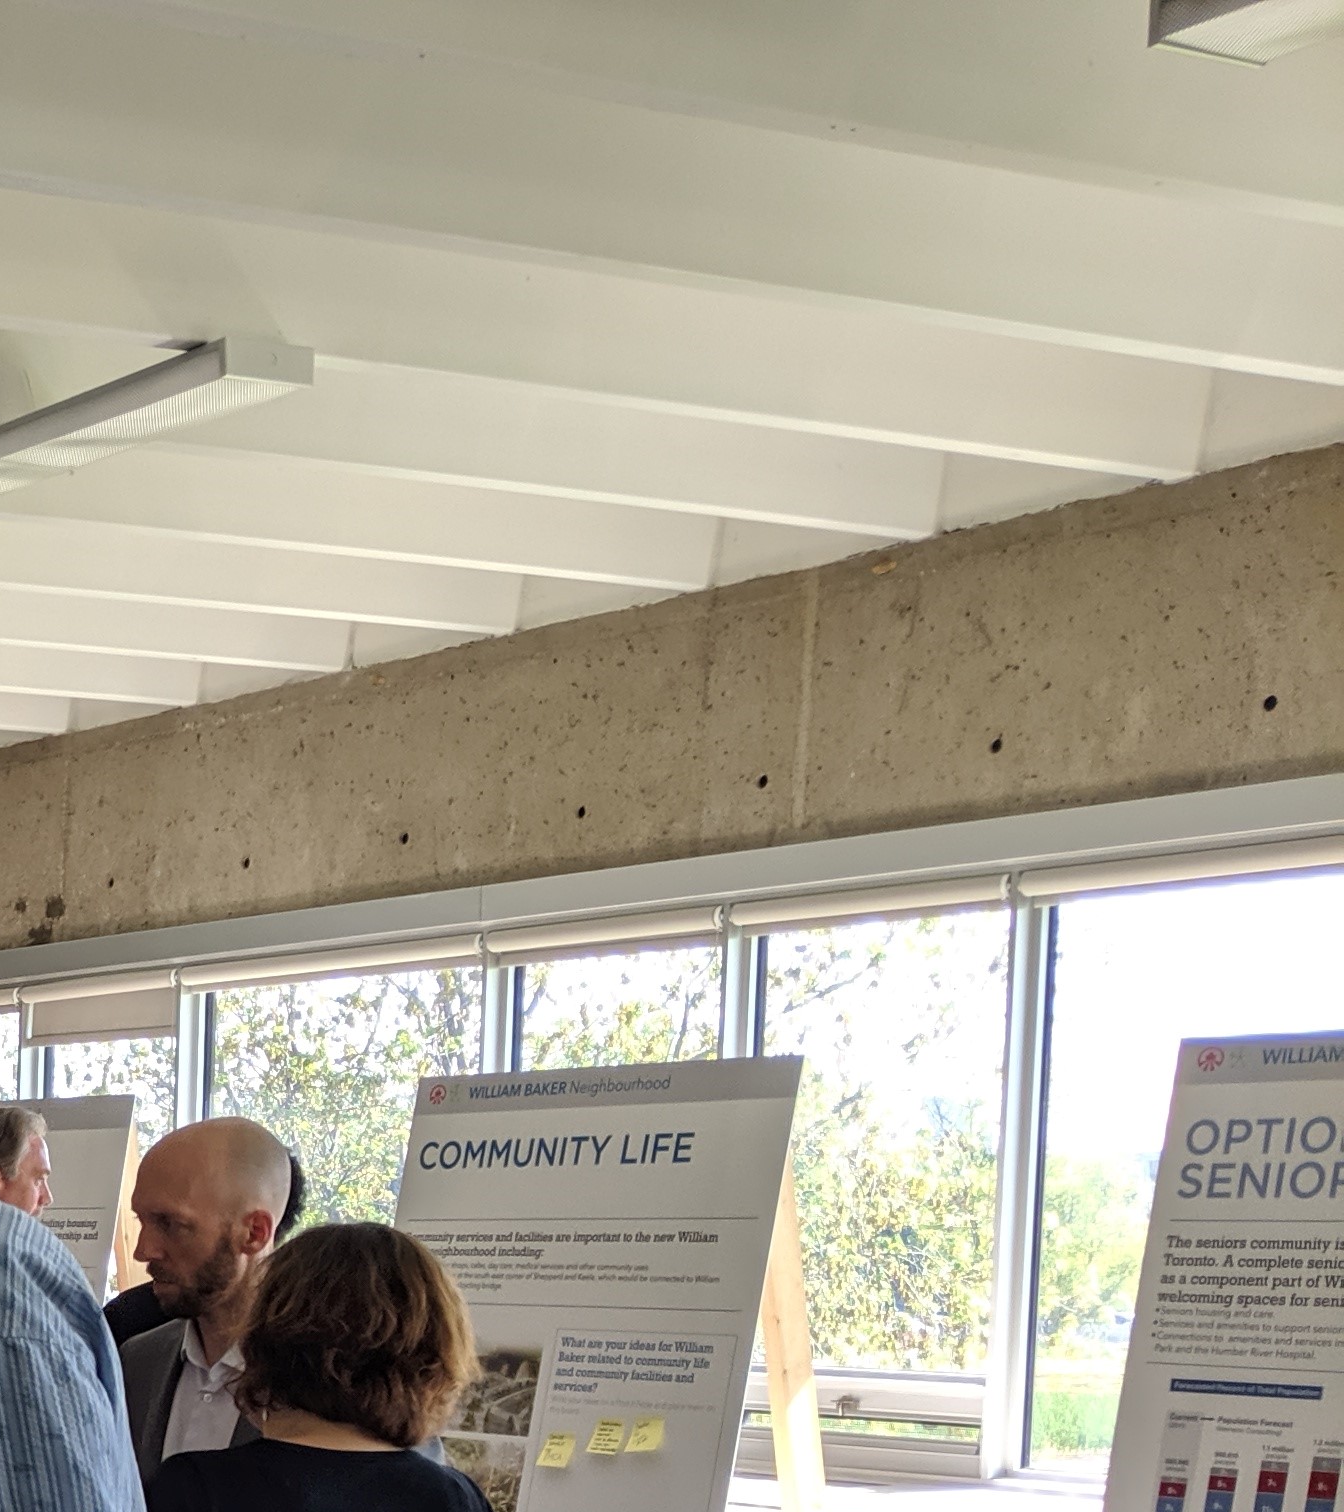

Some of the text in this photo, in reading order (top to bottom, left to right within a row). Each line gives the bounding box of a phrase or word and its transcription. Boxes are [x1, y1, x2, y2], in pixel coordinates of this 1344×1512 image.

[1263, 1045, 1344, 1064] WILLIAM
[469, 1076, 671, 1099] WILLIAM BAKER Neighbourhood
[1186, 1116, 1344, 1155] OPTIO
[420, 1132, 695, 1170] COMMUNITY LIFE
[456, 1231, 718, 1245] services and facilities are important to the new William
[1167, 1234, 1331, 1253] The seniors community
[498, 1246, 544, 1259] including:
[1164, 1254, 1303, 1271] Toronto. A complete
[1161, 1274, 1322, 1290] as a component part of
[1158, 1291, 1310, 1308] welcoming spaces for
[562, 1337, 714, 1353] What are your ideas for William
[558, 1351, 710, 1370] Baker related to community life
[555, 1367, 694, 1383] and community facilities and
[553, 1382, 598, 1393] services?
